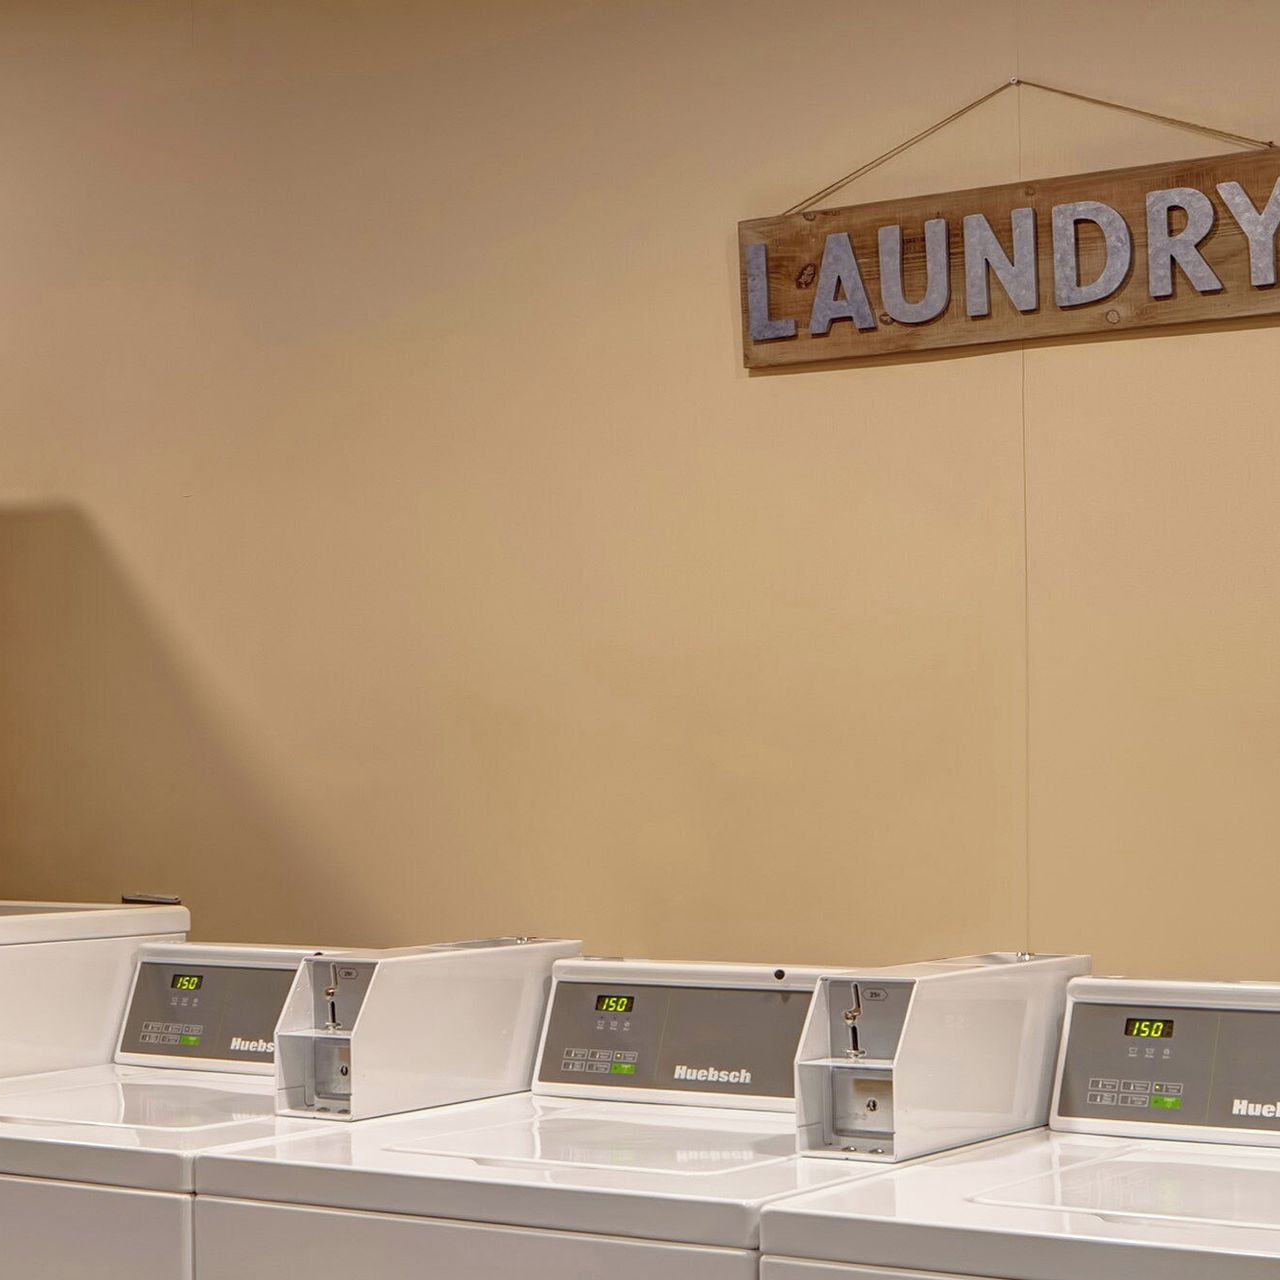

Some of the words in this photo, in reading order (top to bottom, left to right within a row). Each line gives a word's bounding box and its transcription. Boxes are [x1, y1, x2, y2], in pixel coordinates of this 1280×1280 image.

[176, 977, 198, 990] 150
[602, 998, 627, 1012] 150
[1132, 1022, 1163, 1037] 150
[674, 1065, 751, 1083] Huebsch
